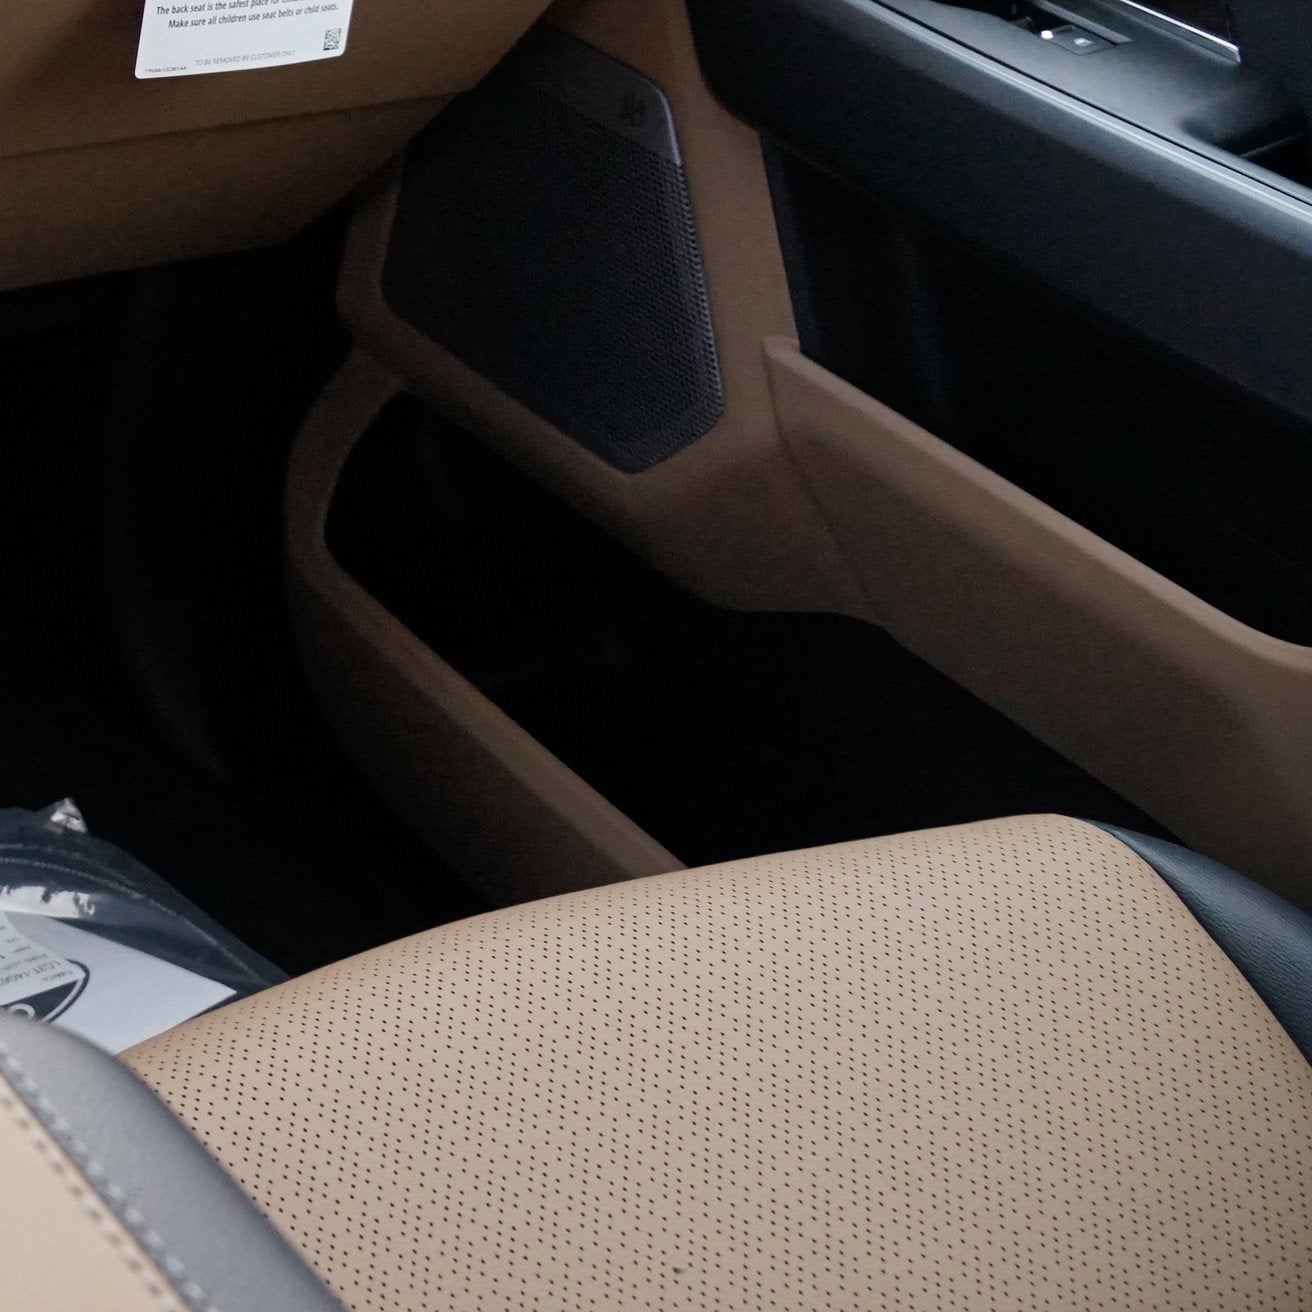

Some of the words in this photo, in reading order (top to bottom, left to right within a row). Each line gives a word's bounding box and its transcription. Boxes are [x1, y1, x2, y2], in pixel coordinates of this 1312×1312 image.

[156, 5, 170, 15] The
[171, 3, 188, 14] back
[189, 3, 206, 12] seat
[206, 2, 214, 11] is
[214, 0, 227, 11] the
[168, 19, 188, 29] Make
[190, 17, 206, 27] sure
[208, 16, 217, 25] all
[218, 13, 247, 24] children
[248, 13, 260, 21] use
[262, 10, 276, 20] seat
[277, 9, 294, 18] belts
[295, 8, 303, 16] or
[304, 3, 319, 14] child
